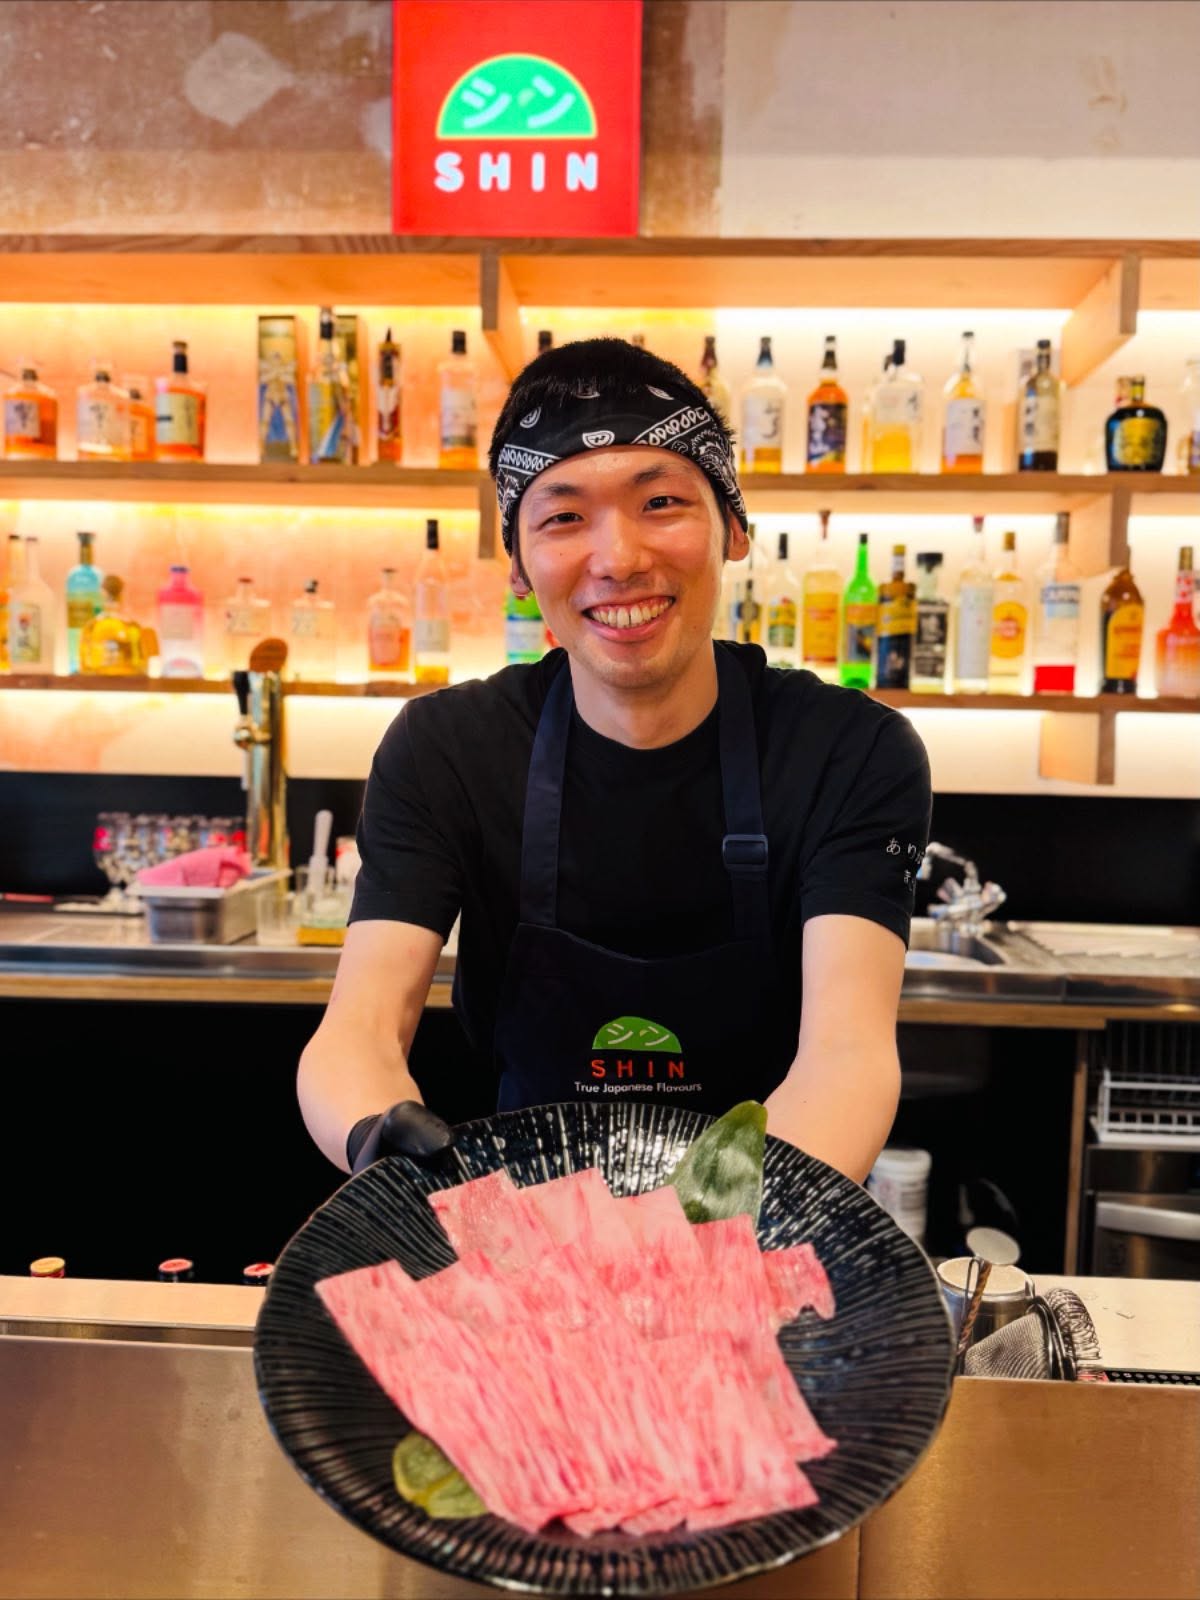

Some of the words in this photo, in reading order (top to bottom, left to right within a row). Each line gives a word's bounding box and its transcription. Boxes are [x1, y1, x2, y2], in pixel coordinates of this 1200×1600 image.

[434, 151, 598, 193] SHIN
[591, 1059, 685, 1078] SHIN
[574, 1081, 600, 1093] True
[602, 1083, 654, 1095] Japanese
[656, 1082, 702, 1093] Flavours
